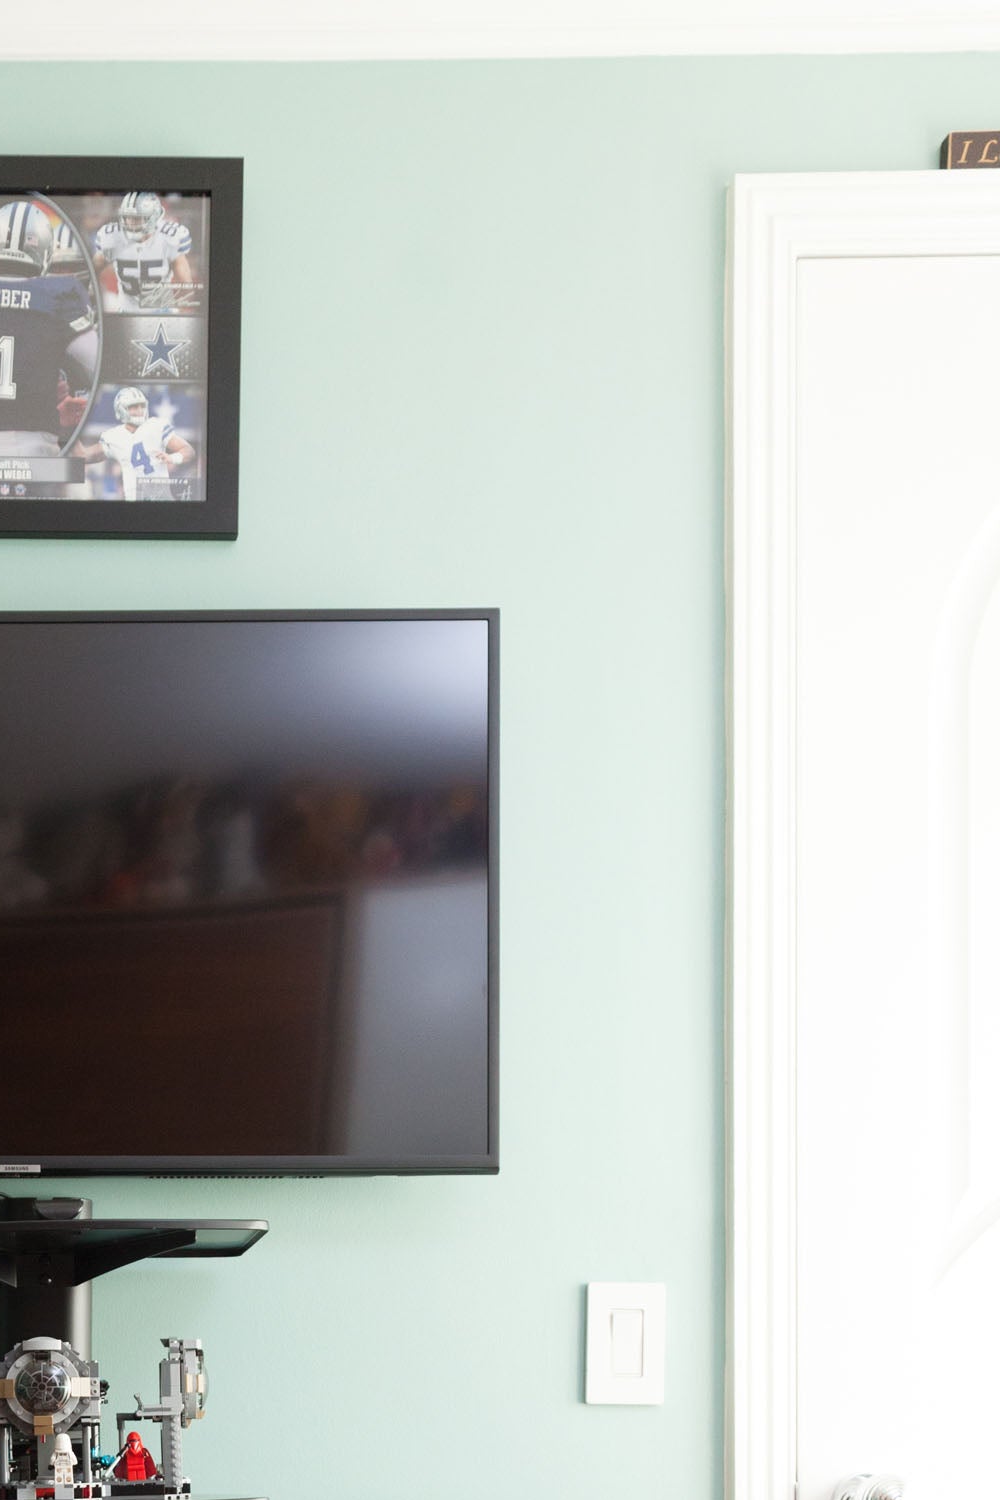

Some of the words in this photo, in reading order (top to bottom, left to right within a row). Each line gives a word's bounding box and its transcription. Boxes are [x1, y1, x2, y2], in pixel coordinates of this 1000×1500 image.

[957, 140, 973, 163] I
[978, 139, 1000, 164] L
[12, 459, 30, 469] Pick
[130, 441, 155, 475] 4
[3, 469, 32, 480] WEBER
